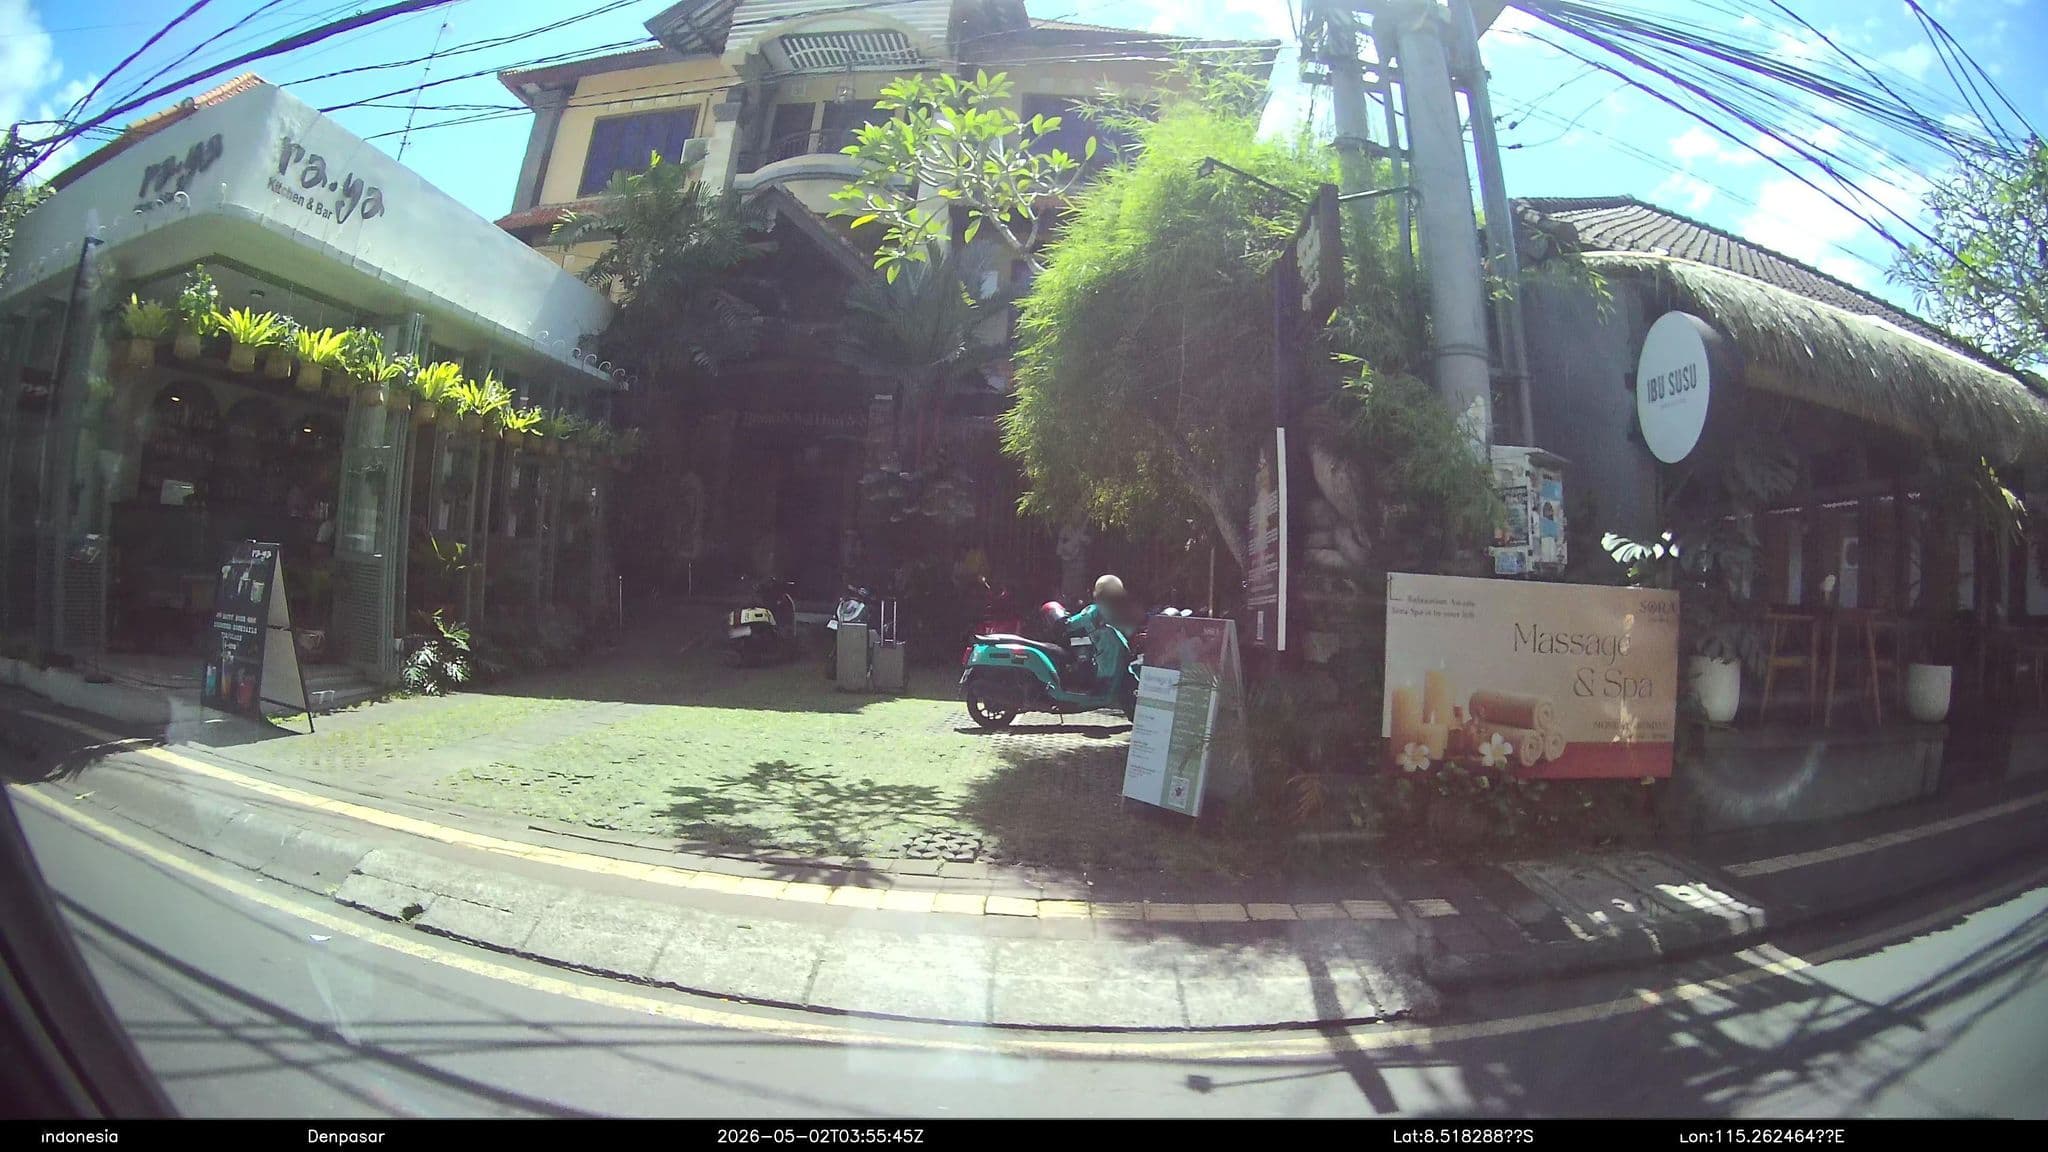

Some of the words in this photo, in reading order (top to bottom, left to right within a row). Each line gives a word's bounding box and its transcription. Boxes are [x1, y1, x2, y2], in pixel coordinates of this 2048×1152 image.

[267, 177, 305, 209] Kitchen
[305, 196, 315, 210] &
[314, 199, 333, 220] Bar
[278, 136, 385, 224] ra.ya
[1647, 375, 1665, 404] IBU
[1668, 362, 1697, 396] SUSU
[1513, 622, 1632, 665] Massage
[1573, 667, 1595, 698] &
[1603, 669, 1653, 701] Spa
